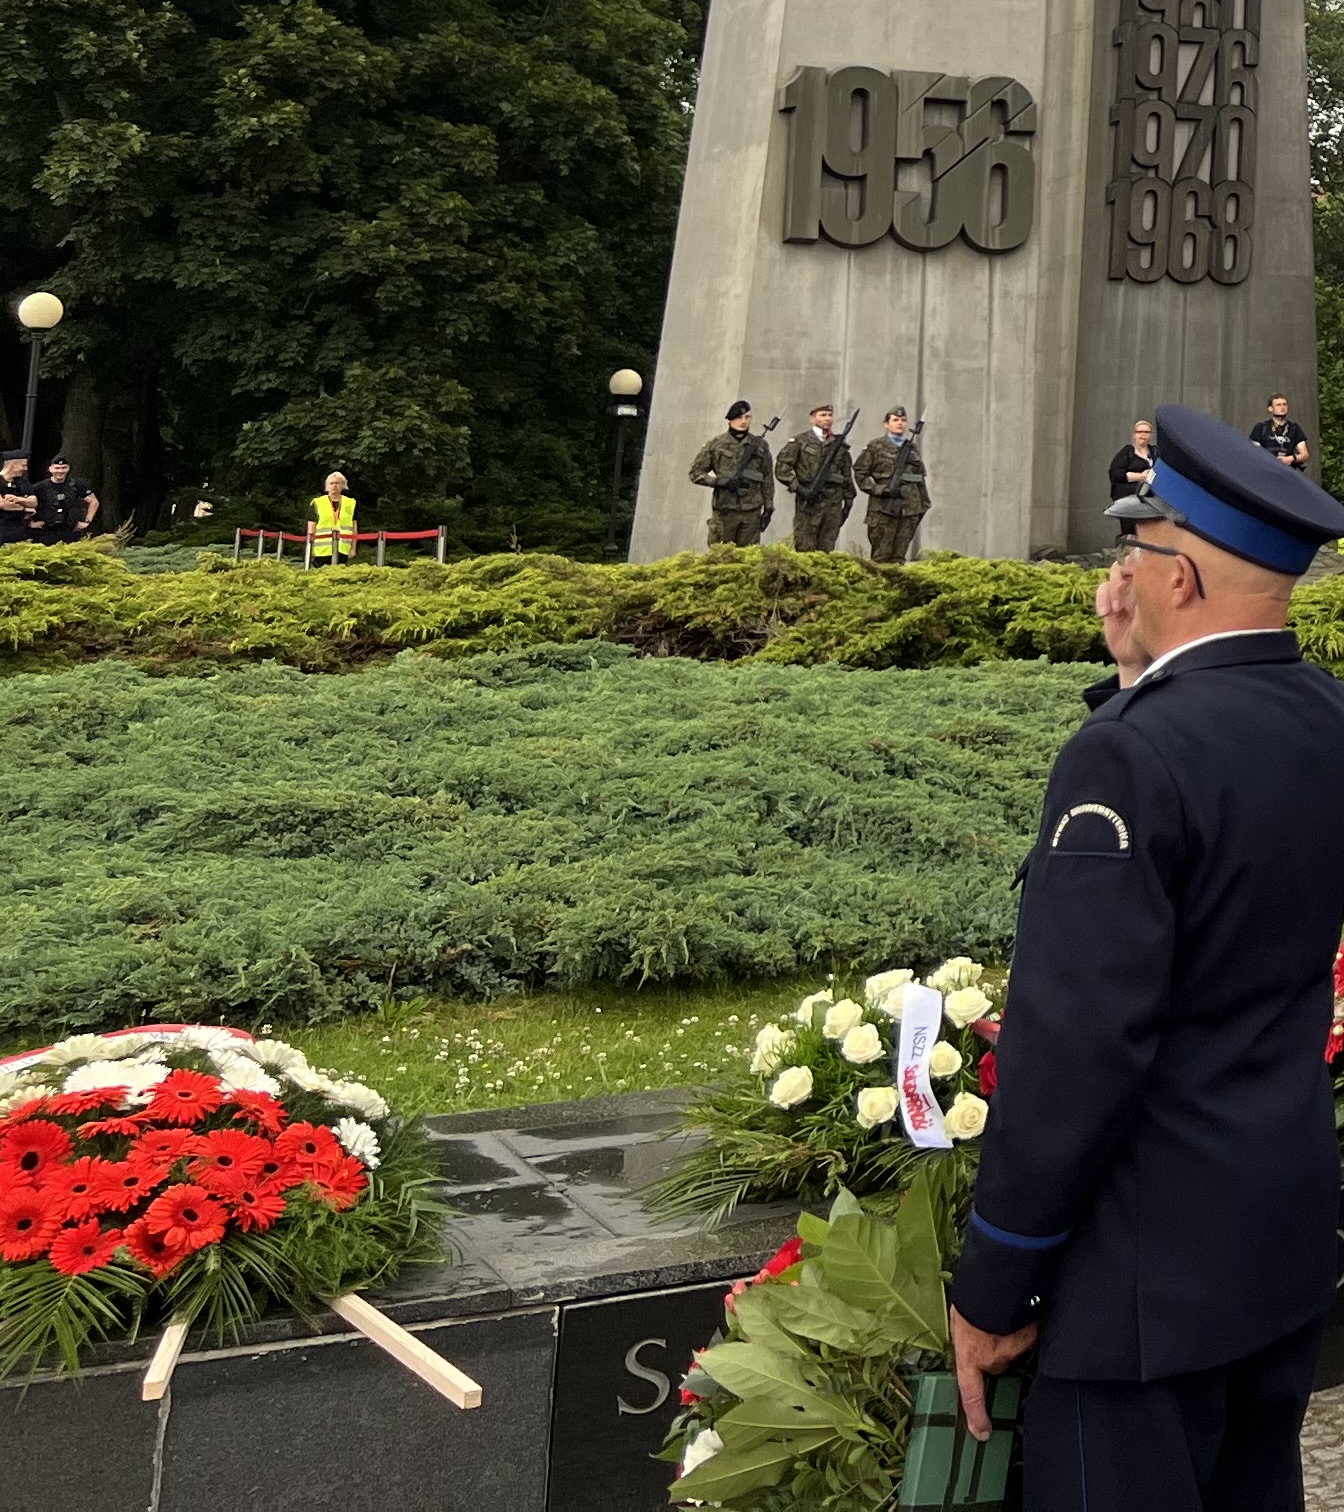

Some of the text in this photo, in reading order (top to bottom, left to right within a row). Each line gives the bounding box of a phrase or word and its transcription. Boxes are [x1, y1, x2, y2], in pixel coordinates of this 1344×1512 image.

[1112, 21, 1260, 118] 1976
[779, 64, 1037, 255] 1956
[1109, 98, 1258, 188] 1970
[1105, 176, 1255, 286] 1968
[911, 1026, 929, 1061] NSZZ
